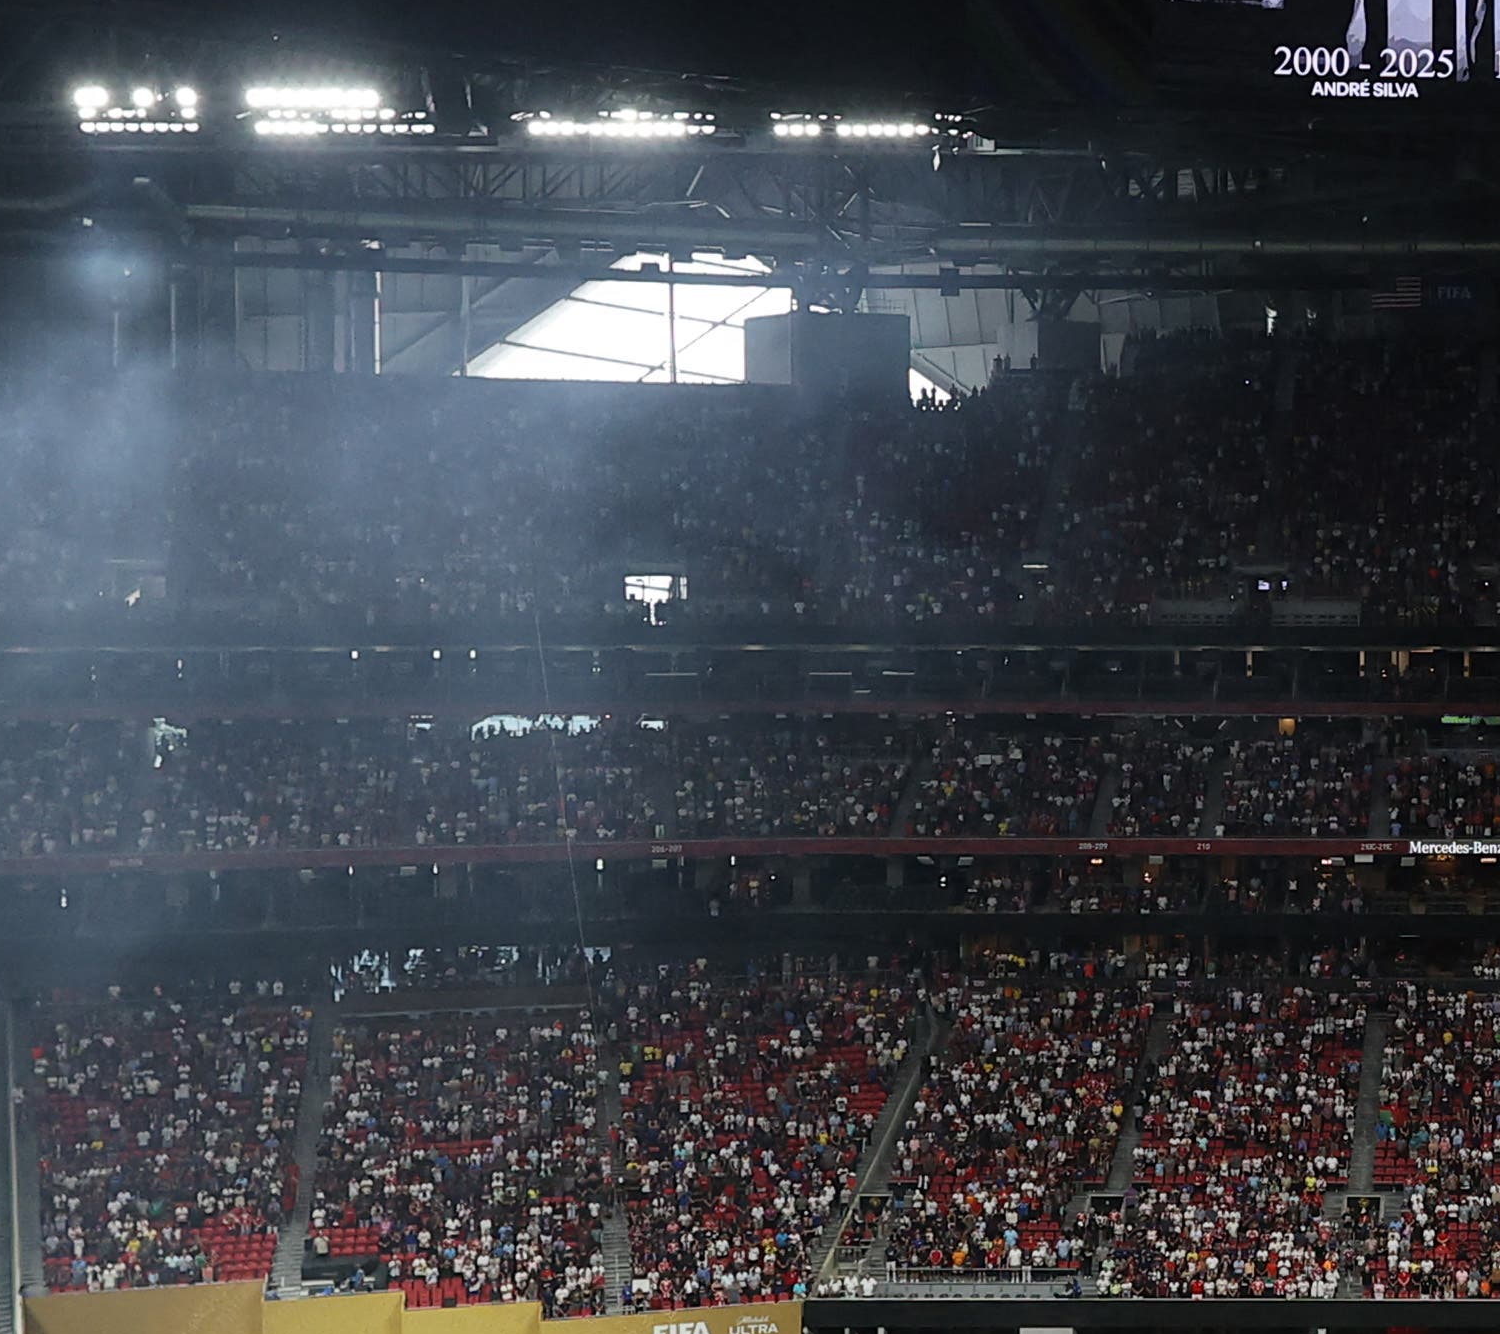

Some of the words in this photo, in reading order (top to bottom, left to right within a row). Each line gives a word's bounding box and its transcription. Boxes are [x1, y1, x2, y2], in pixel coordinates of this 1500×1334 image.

[1274, 47, 1350, 78] 2000
[1379, 48, 1454, 79] 2025
[1311, 79, 1370, 98] ANDRÉ
[1372, 81, 1419, 99] SILVA
[1437, 286, 1471, 299] FIFA
